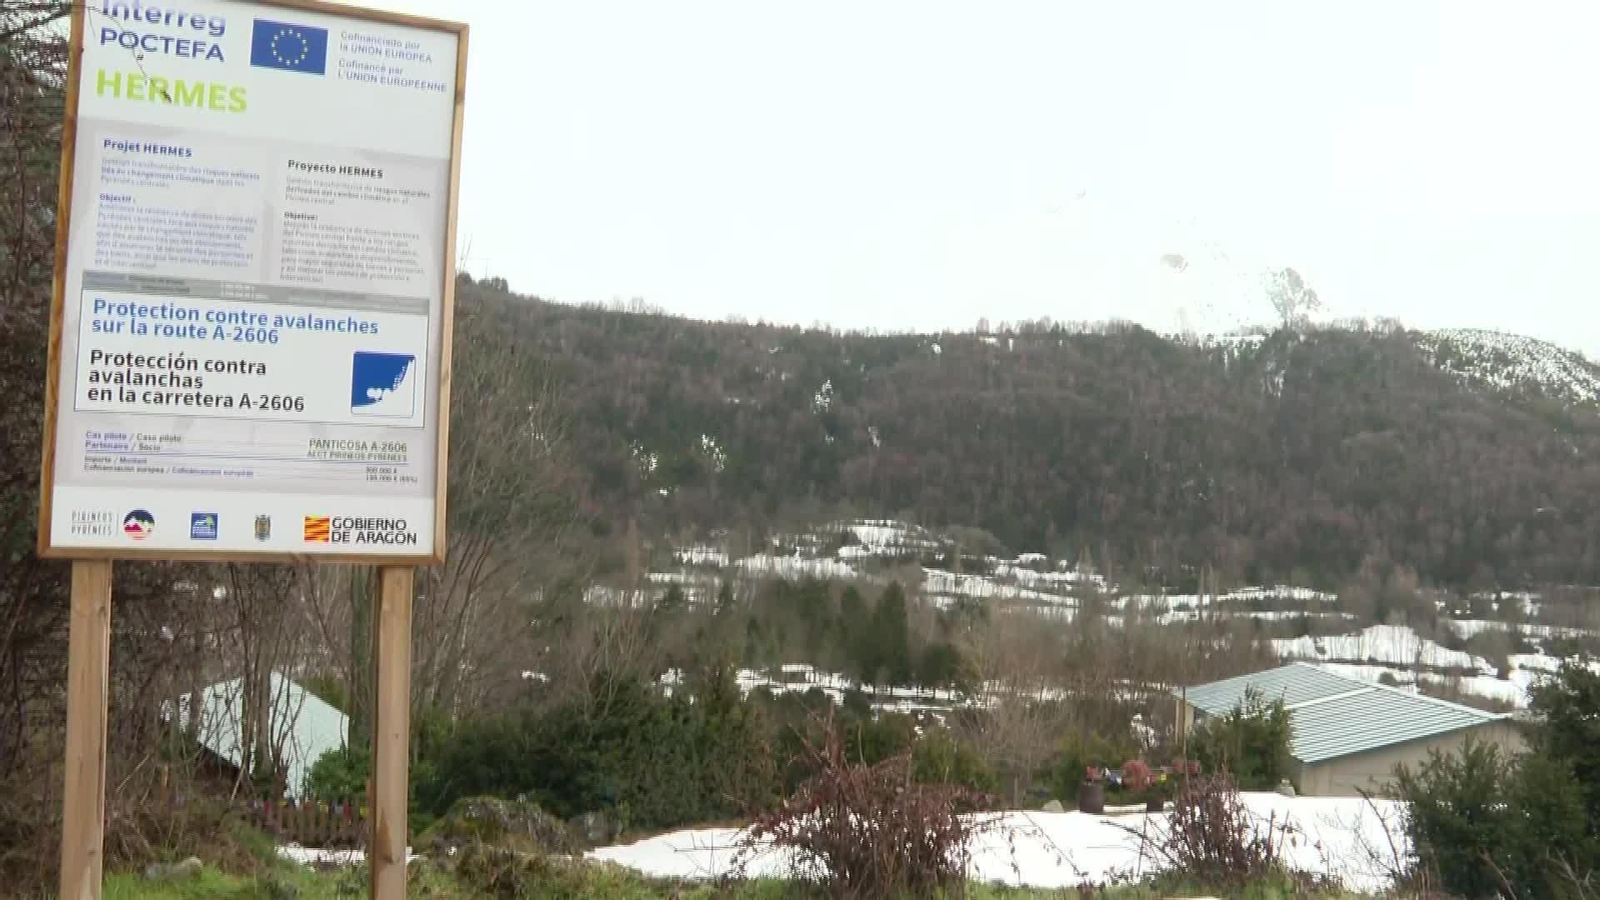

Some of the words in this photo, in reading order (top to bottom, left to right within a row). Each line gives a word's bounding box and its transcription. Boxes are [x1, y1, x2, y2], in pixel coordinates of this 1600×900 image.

[102, 0, 226, 37] Interreg
[100, 27, 225, 62] POCTEFA
[385, 48, 432, 63] EUROPEA
[96, 68, 247, 113] HERMES
[103, 139, 140, 153] Projet
[143, 143, 192, 158] HERMES
[287, 159, 336, 174] Proyecto
[339, 164, 384, 179] HERMES
[93, 299, 200, 323] Protection
[205, 307, 268, 326] contre
[273, 313, 379, 335] avalanches
[92, 319, 125, 334] sur
[130, 317, 148, 336] la
[153, 321, 208, 340] route
[212, 326, 279, 344] A-2606
[90, 349, 199, 373] Protección
[204, 359, 267, 376] contra
[88, 368, 204, 389] avalanchas
[88, 387, 113, 402] en
[118, 386, 137, 403] la
[142, 389, 234, 408] carretera
[238, 393, 305, 412] A-2606
[309, 439, 368, 452] PANTICOSA
[370, 441, 407, 453] A-2606
[331, 515, 407, 531] GOBIERNO
[331, 531, 350, 543] DE
